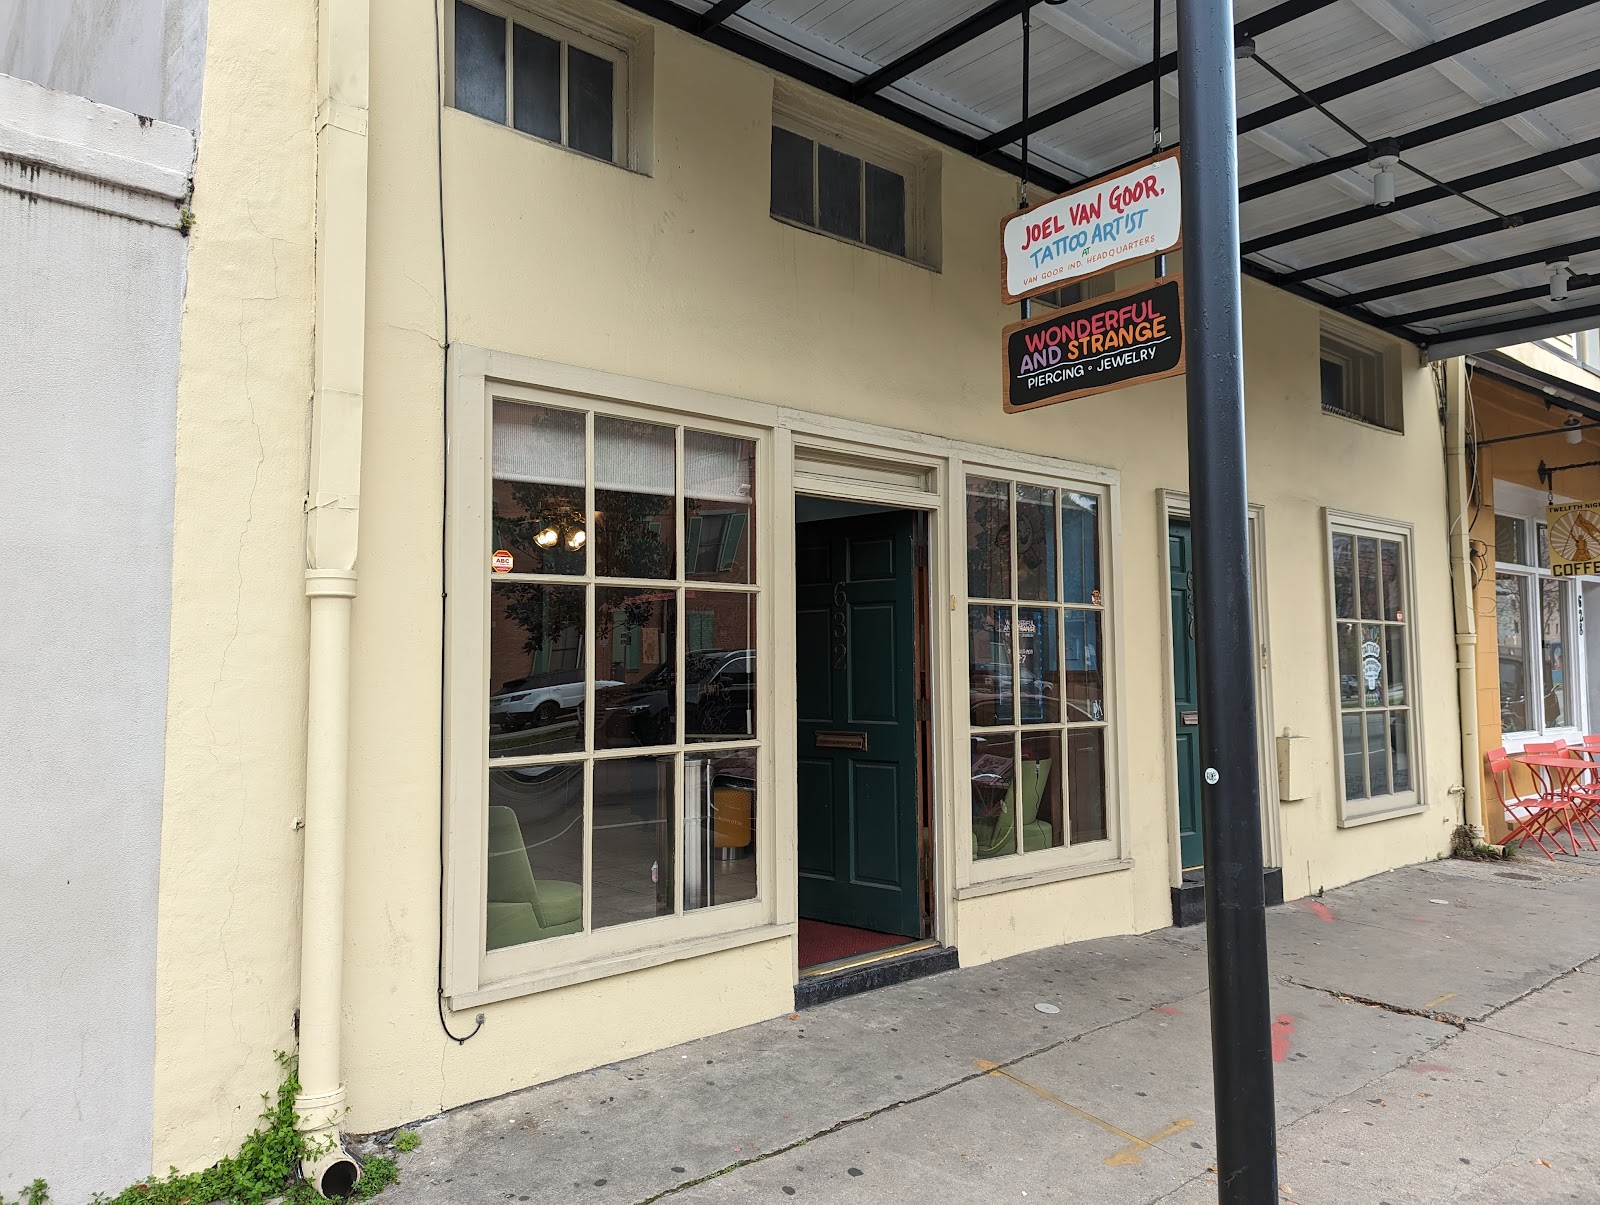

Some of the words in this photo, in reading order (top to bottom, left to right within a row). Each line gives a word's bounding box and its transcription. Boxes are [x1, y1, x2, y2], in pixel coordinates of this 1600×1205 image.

[1022, 215, 1064, 250] JOEL
[1070, 193, 1102, 226] VAN
[1109, 175, 1165, 214] GOOR,
[1030, 230, 1088, 269] TATTOO
[1091, 209, 1148, 245] ARTIST
[1024, 274, 1038, 286] VAN
[1042, 267, 1063, 280] GOOR
[1068, 260, 1083, 271] IND.
[1087, 235, 1155, 265] HEADQUARTERS
[1081, 247, 1090, 257] AT
[1020, 346, 1062, 374] AND
[1067, 316, 1167, 360] STRANGE
[1025, 299, 1161, 353] WONDERFUL
[1028, 365, 1084, 388] PIERCING
[1097, 347, 1156, 371] JEWELRY
[1549, 505, 1583, 513] TWELFTH
[833, 581, 847, 671] 632
